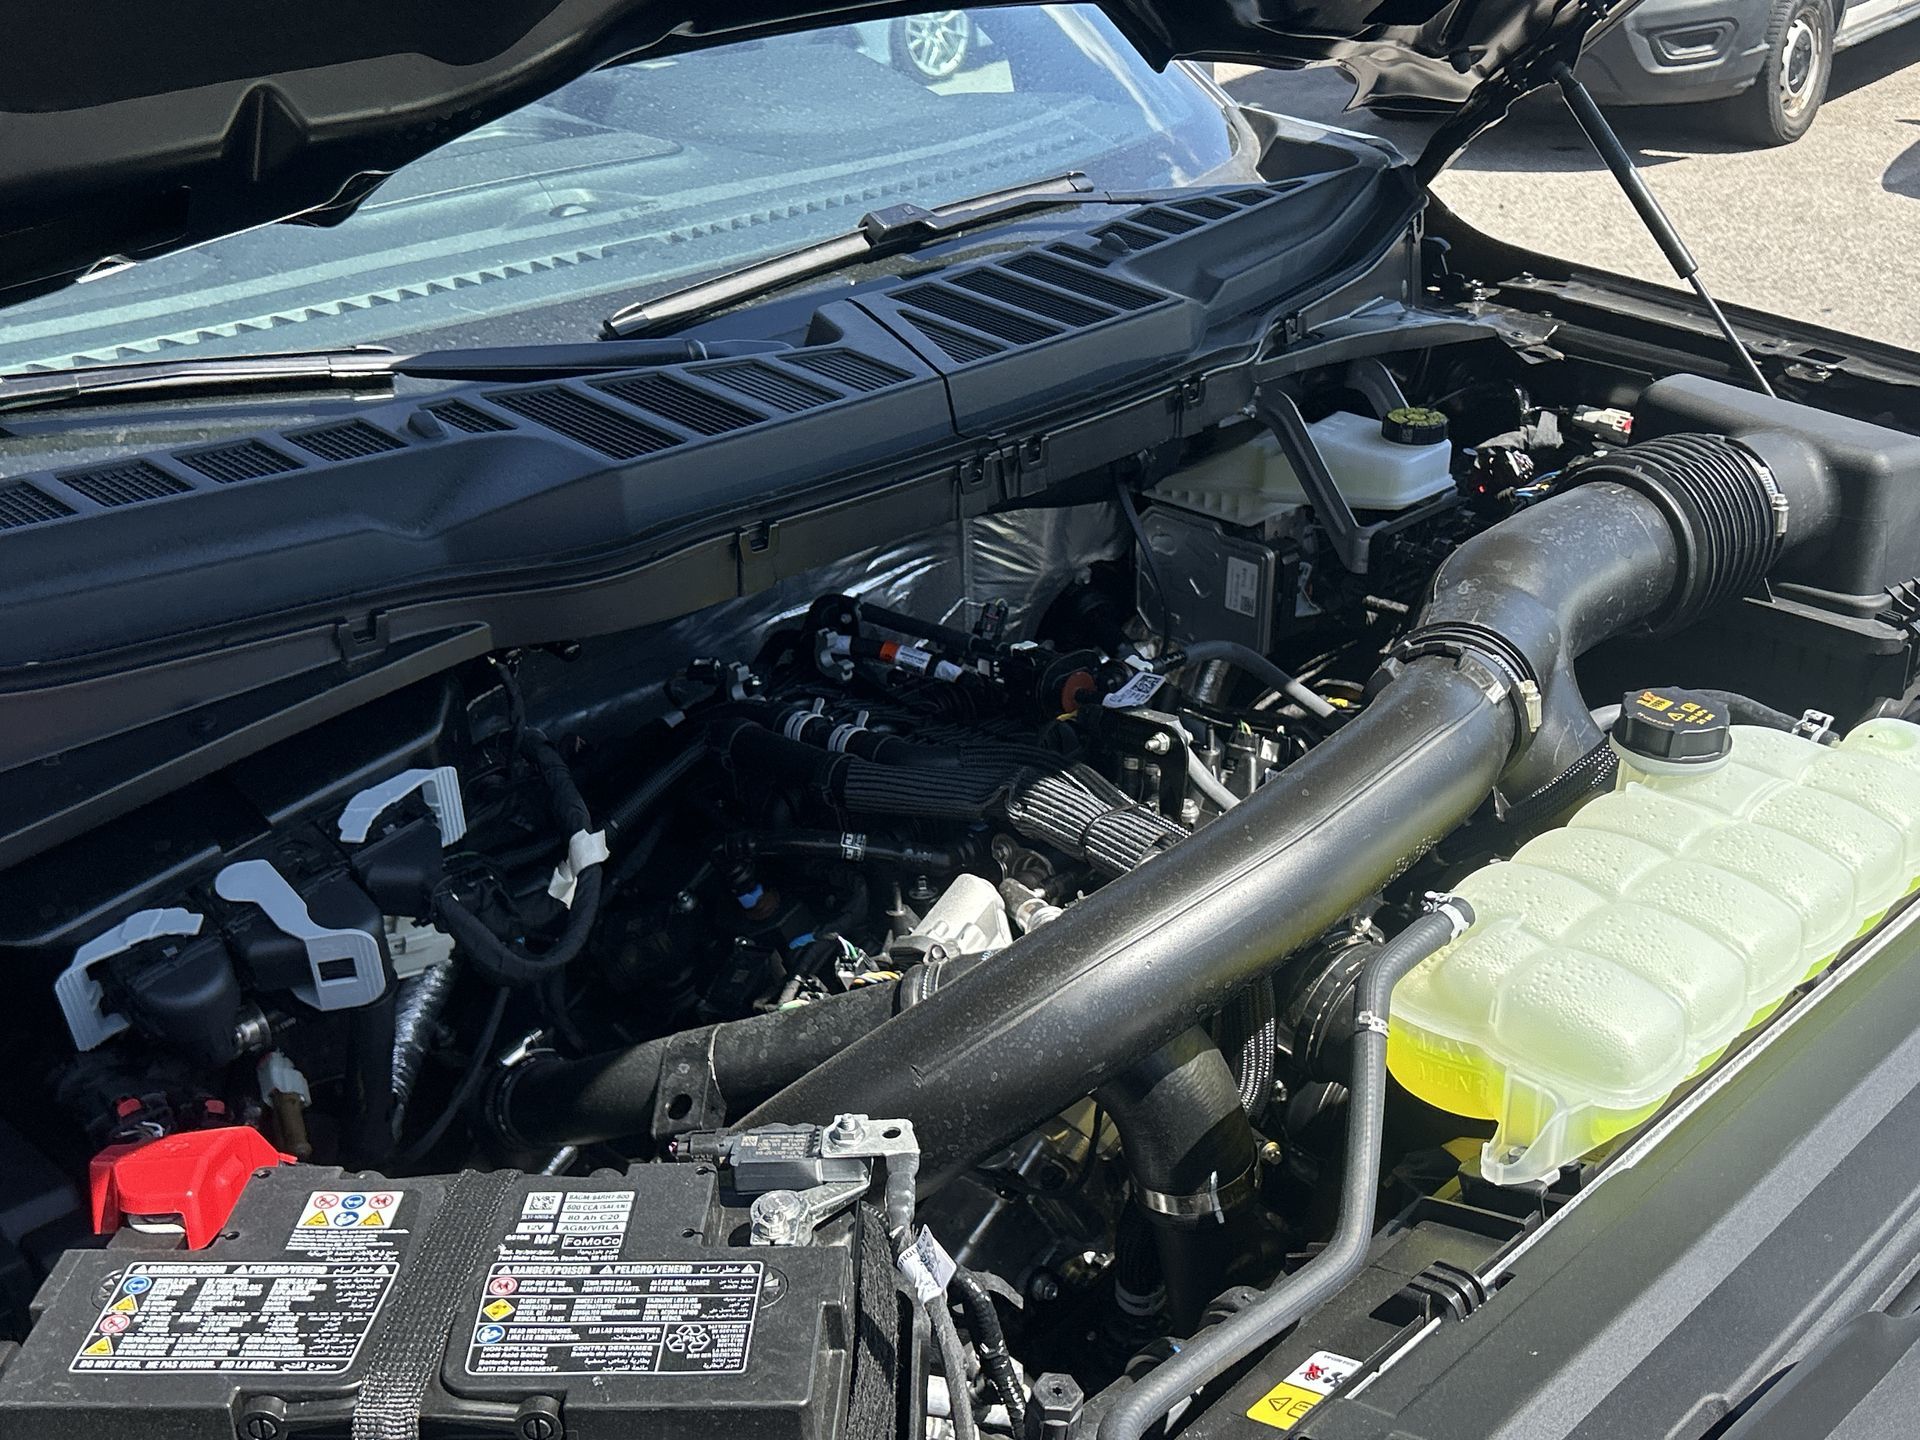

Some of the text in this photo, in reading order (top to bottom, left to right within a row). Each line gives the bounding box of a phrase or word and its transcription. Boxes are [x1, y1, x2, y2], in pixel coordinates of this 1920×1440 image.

[1418, 1032, 1472, 1065] MAX
[1420, 1061, 1470, 1094] MIN
[582, 1203, 598, 1211] CCA
[534, 1234, 560, 1245] MF
[564, 1237, 620, 1246] FoMoCo
[148, 1265, 327, 1274] DANGER/POISON PELIGRO/VENENO
[512, 1265, 591, 1275] DANGER/POISON
[614, 1264, 693, 1274] PELIGRO/VENENO
[79, 1360, 142, 1369] DO NOT OPEN.
[145, 1360, 216, 1369] NE PAS OUVRIR.
[220, 1360, 277, 1369] NO LA ABRA.
